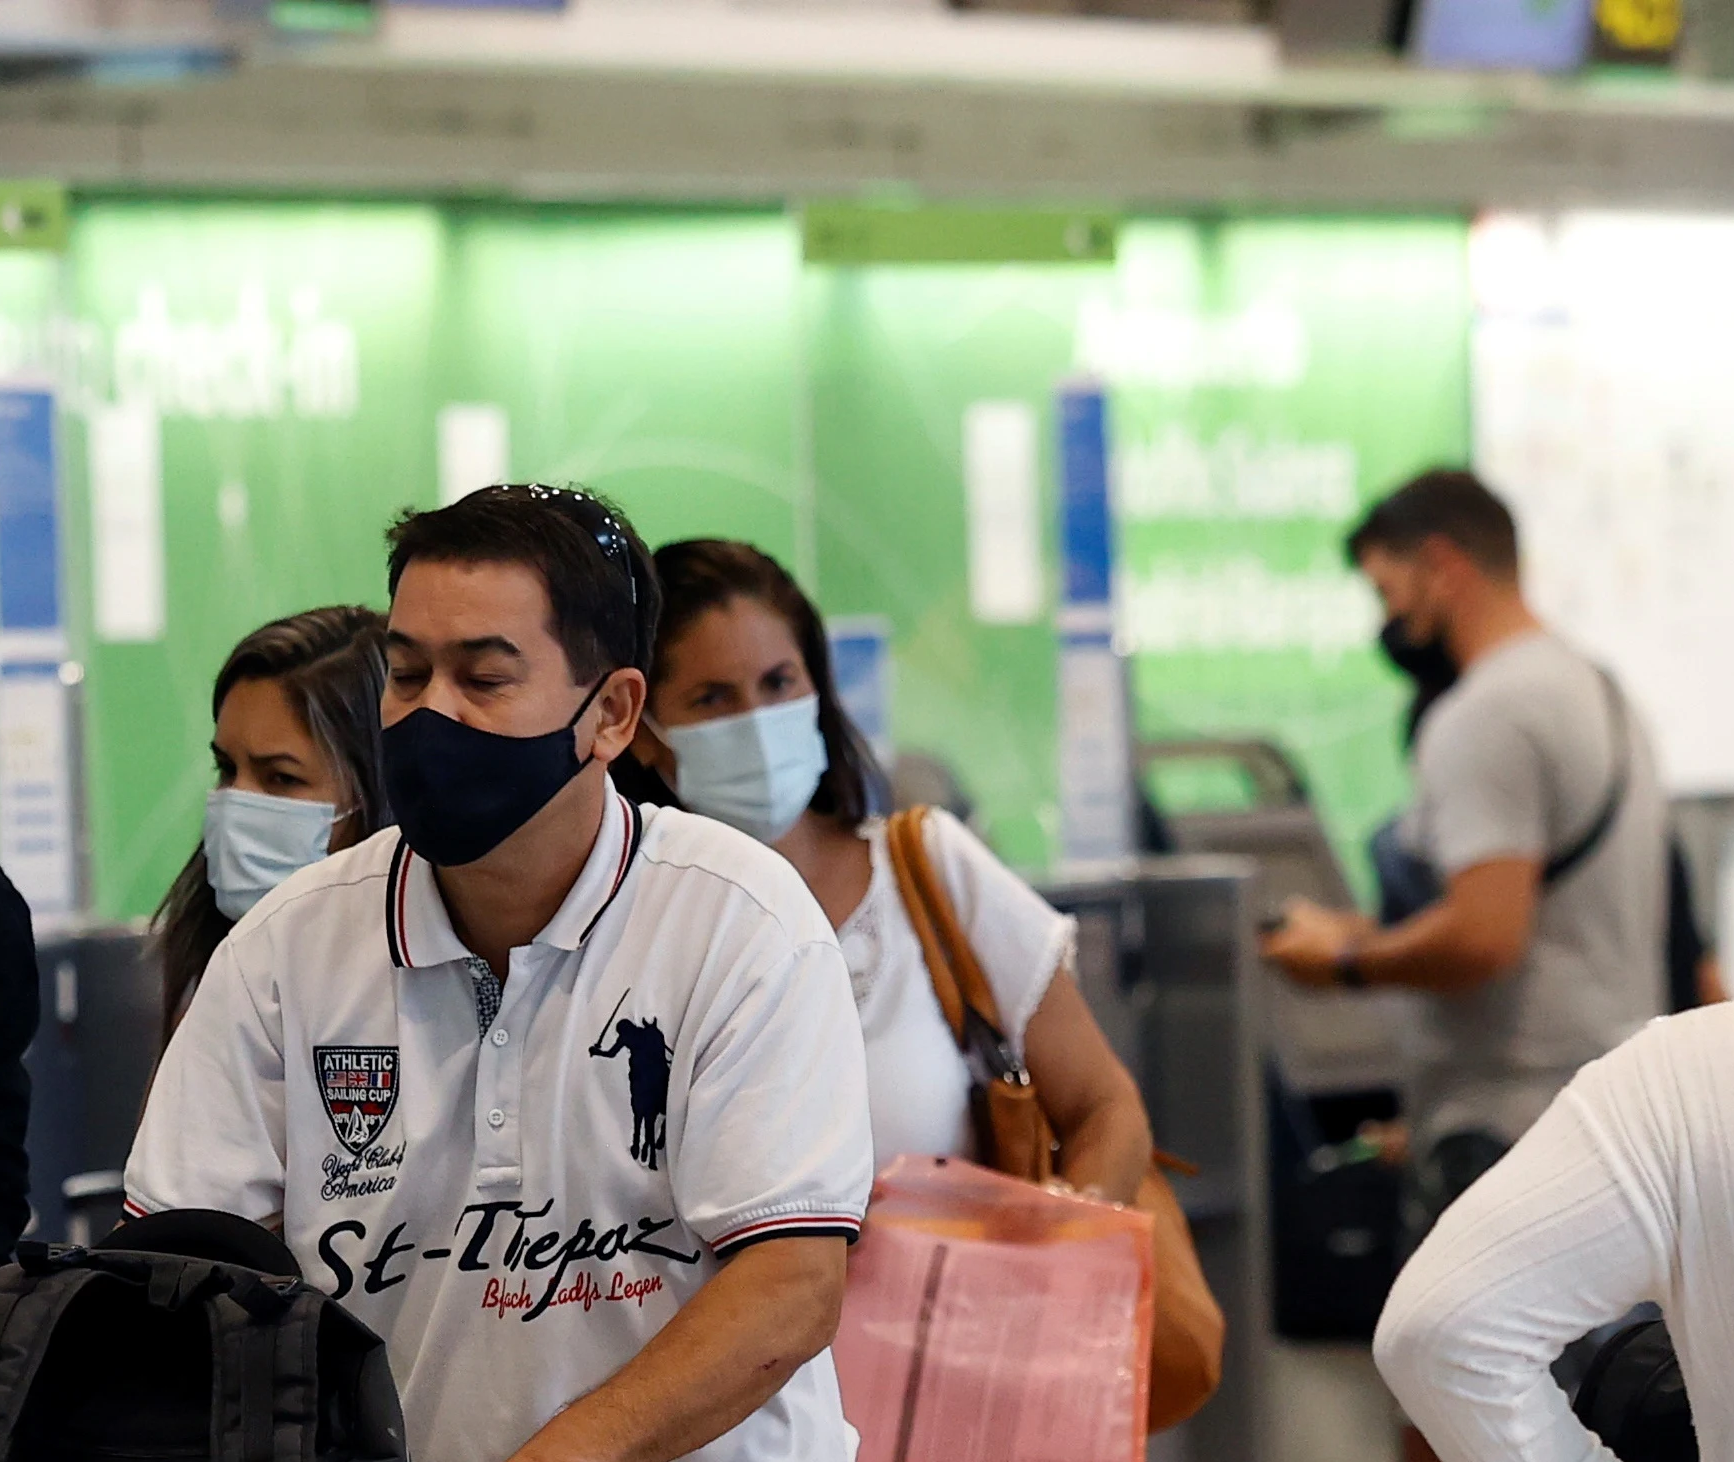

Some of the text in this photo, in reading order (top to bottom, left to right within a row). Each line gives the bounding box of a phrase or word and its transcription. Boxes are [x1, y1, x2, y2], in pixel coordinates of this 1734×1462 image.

[323, 1054, 394, 1071] ATHLETIC
[327, 1088, 391, 1102] SAILING CUP
[321, 1175, 397, 1201] America
